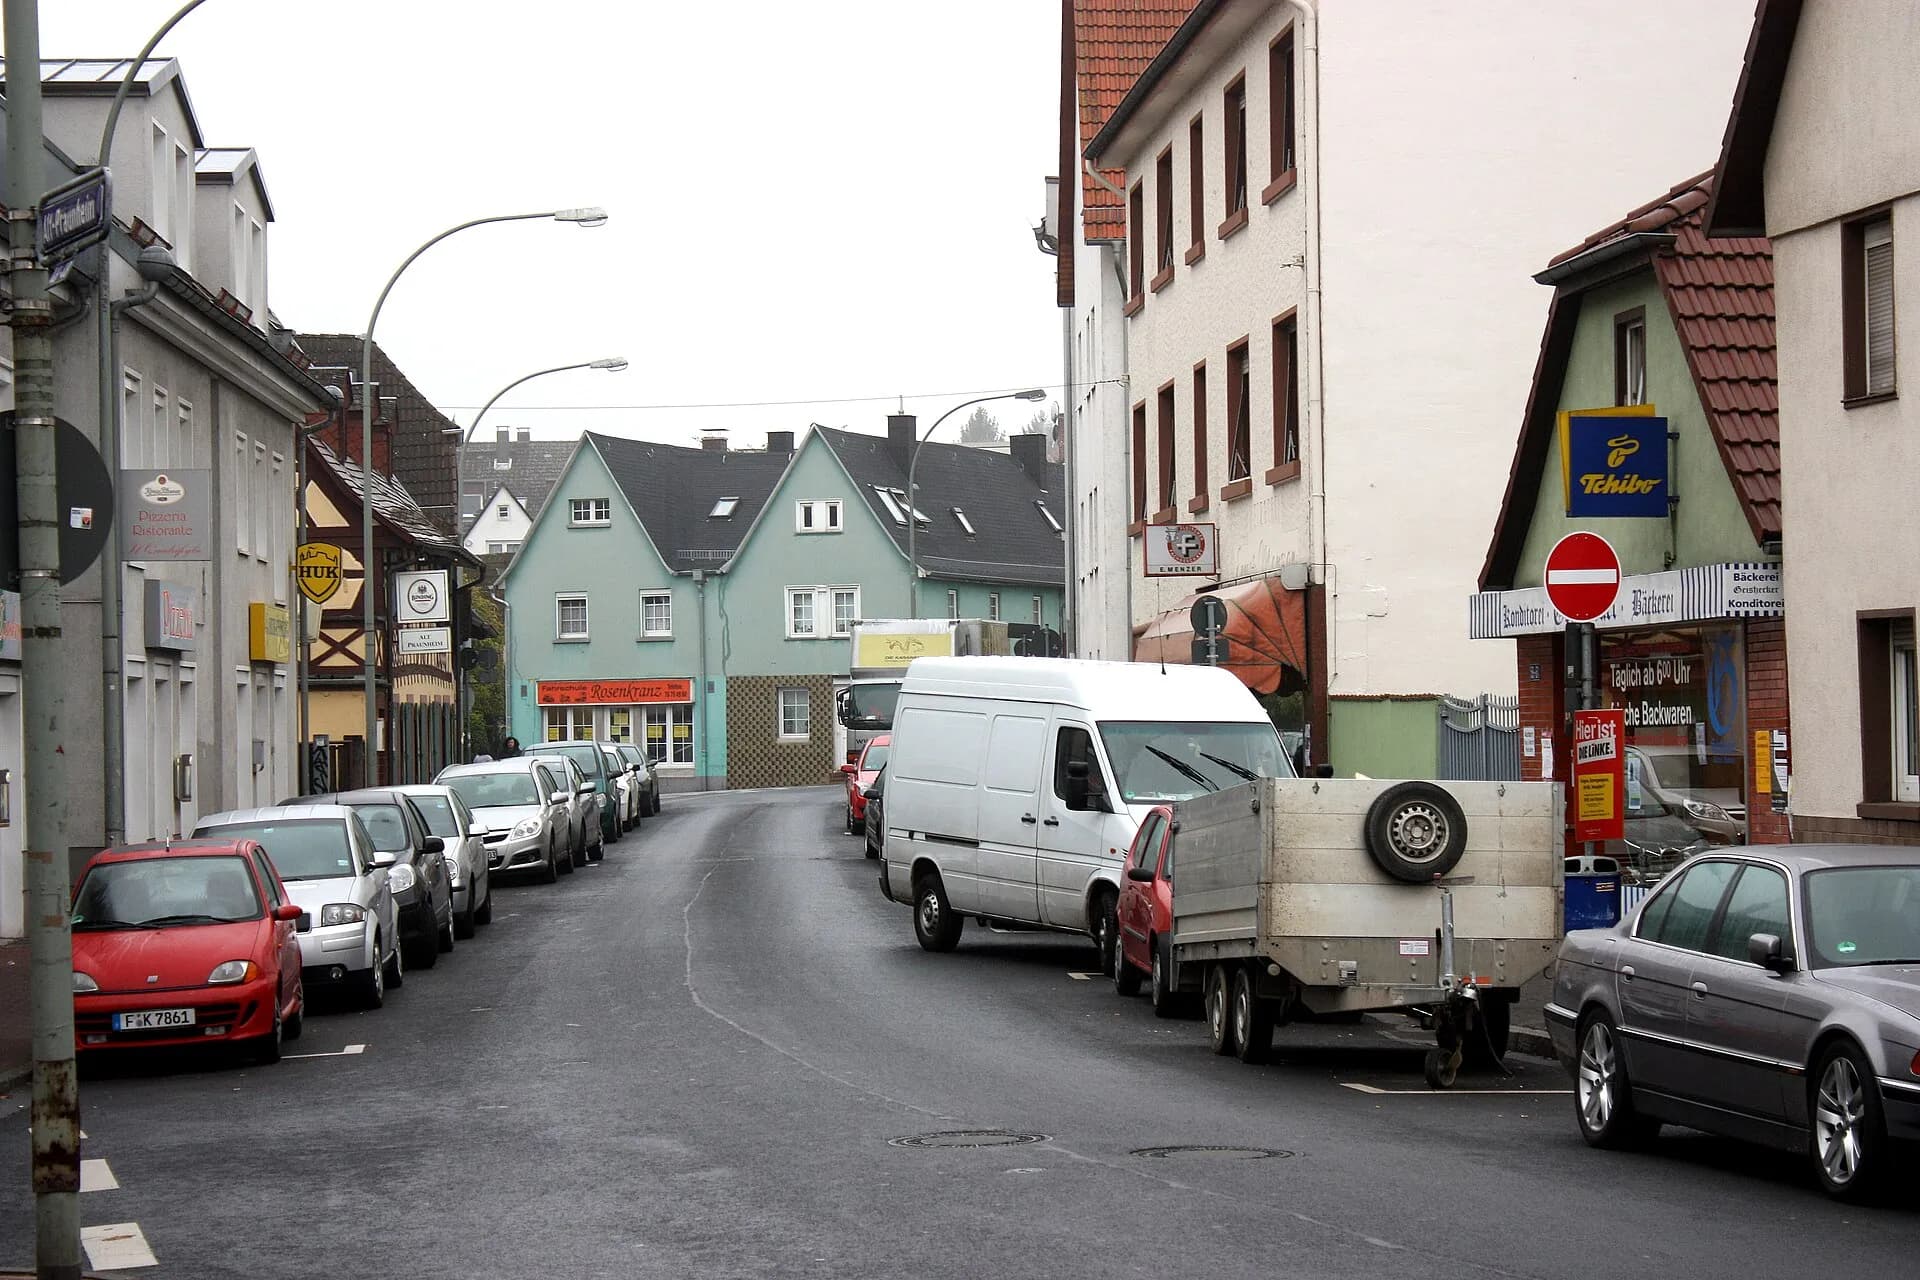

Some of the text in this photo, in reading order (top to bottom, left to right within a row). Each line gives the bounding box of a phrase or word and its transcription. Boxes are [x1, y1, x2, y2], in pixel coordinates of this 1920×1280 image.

[1579, 473, 1663, 495] Tchibo
[138, 510, 187, 522] Pizzeria
[131, 524, 193, 537] Ristorante
[298, 566, 339, 579] HUK
[1733, 572, 1779, 582] Bäckerei
[1503, 604, 1545, 628] Konditorei
[1632, 589, 1674, 617] Bäckerei
[1728, 598, 1785, 608] Konditorei
[1610, 661, 1642, 692] Täglich
[1643, 661, 1655, 686] ab
[1673, 659, 1691, 685] Uhr
[542, 684, 588, 692] Fahrschule
[591, 681, 663, 702] Rosenkranz
[1641, 700, 1692, 726] Backwaren
[1575, 718, 1617, 740] Hier ist
[1578, 745, 1588, 760] DIE
[155, 1010, 190, 1025] 7861
